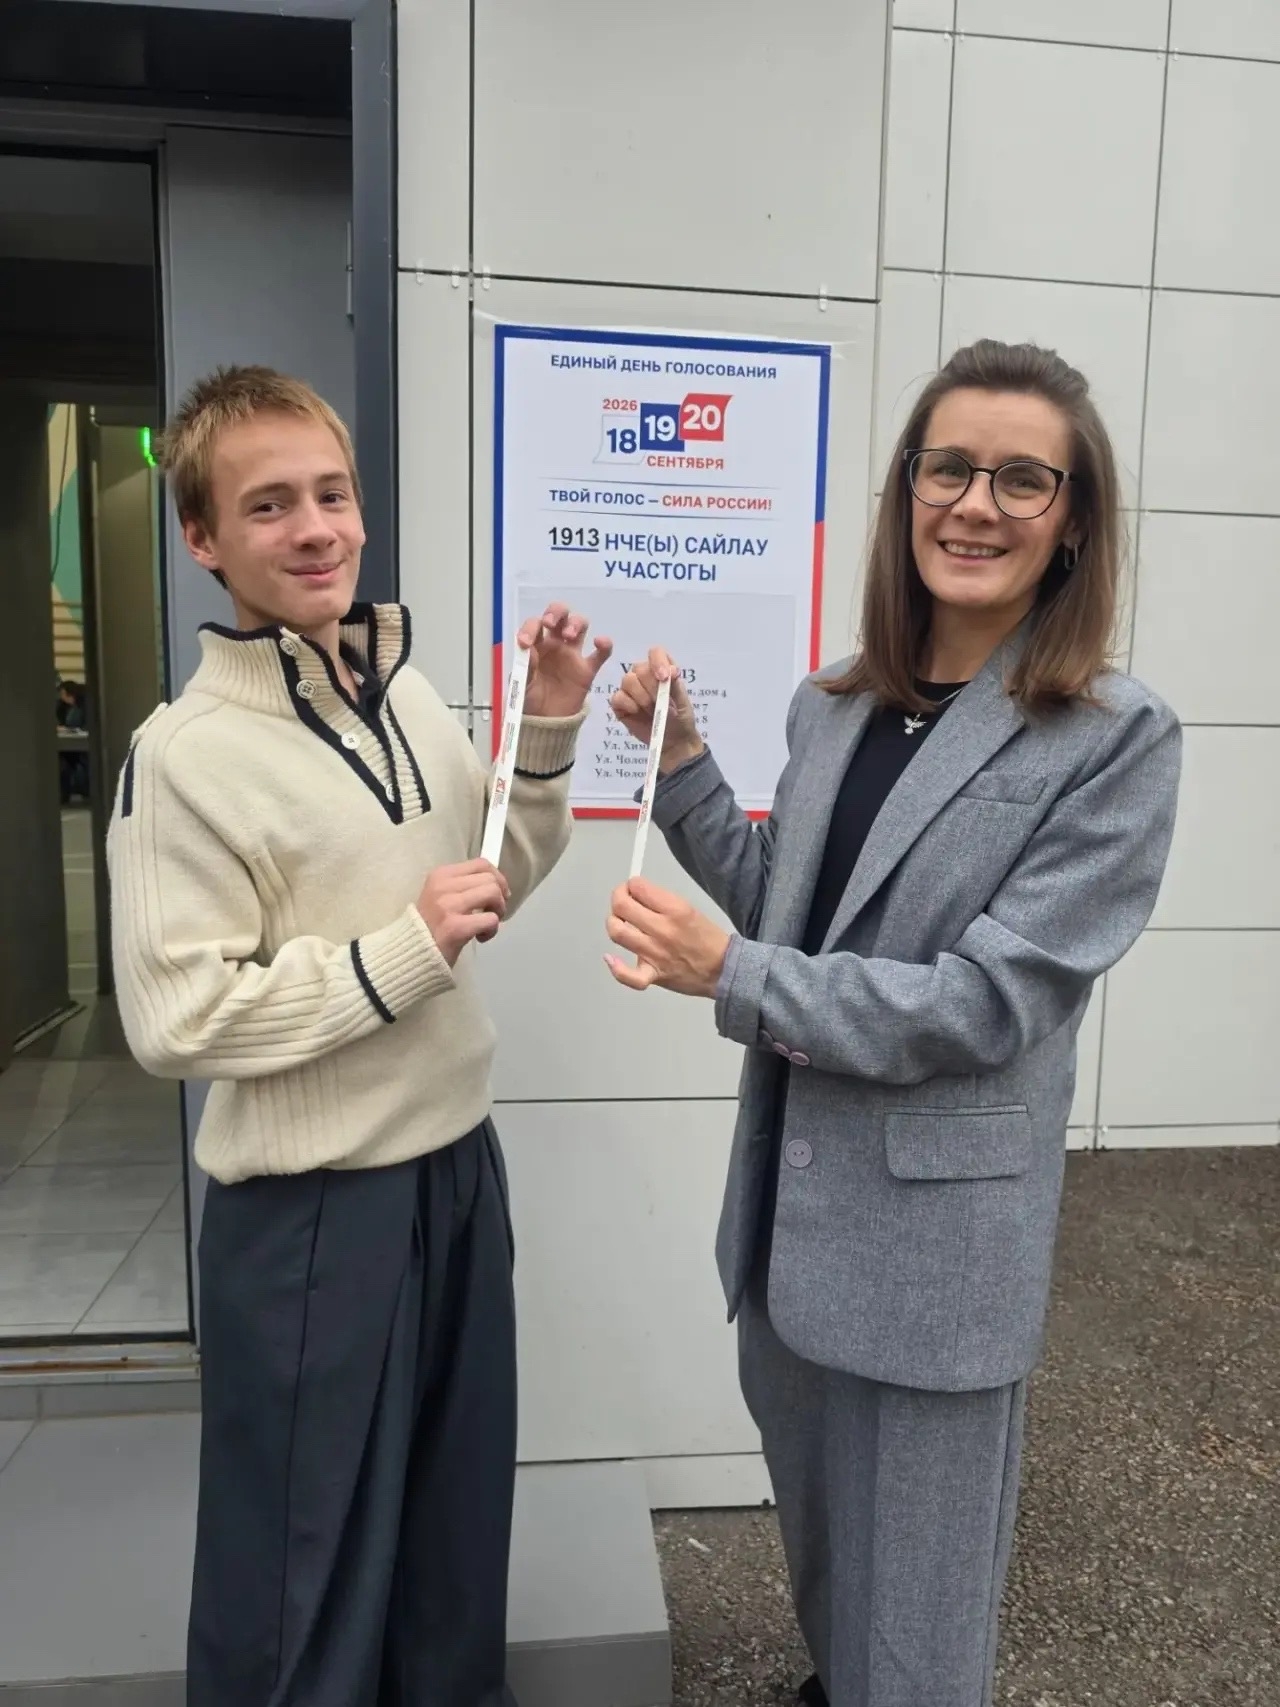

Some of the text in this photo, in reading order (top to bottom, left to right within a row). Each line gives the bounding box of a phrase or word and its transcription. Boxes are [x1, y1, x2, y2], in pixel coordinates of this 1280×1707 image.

[551, 354, 777, 379] ЕДИНЫЙ ДЕНЬ ГОЛОСОВАНИЯ
[602, 399, 638, 411] 2026
[606, 404, 721, 454] 18 19 20
[646, 455, 724, 470] СЕНТЯБРЯ
[549, 488, 591, 503] ТВОЙ
[594, 492, 645, 506] ГОЛОС
[662, 494, 703, 508] СИЛА
[706, 497, 772, 511] РОССИИ!
[548, 527, 769, 557] 1913 НЧЕ(Ы) САЙЛАУ
[605, 560, 716, 581] УЧАСТОГЫ
[702, 703, 709, 712] 7
[702, 715, 708, 724] 8
[603, 740, 649, 751] Ул. Хим
[595, 753, 612, 764] Ул.
[594, 767, 612, 778] Ул.
